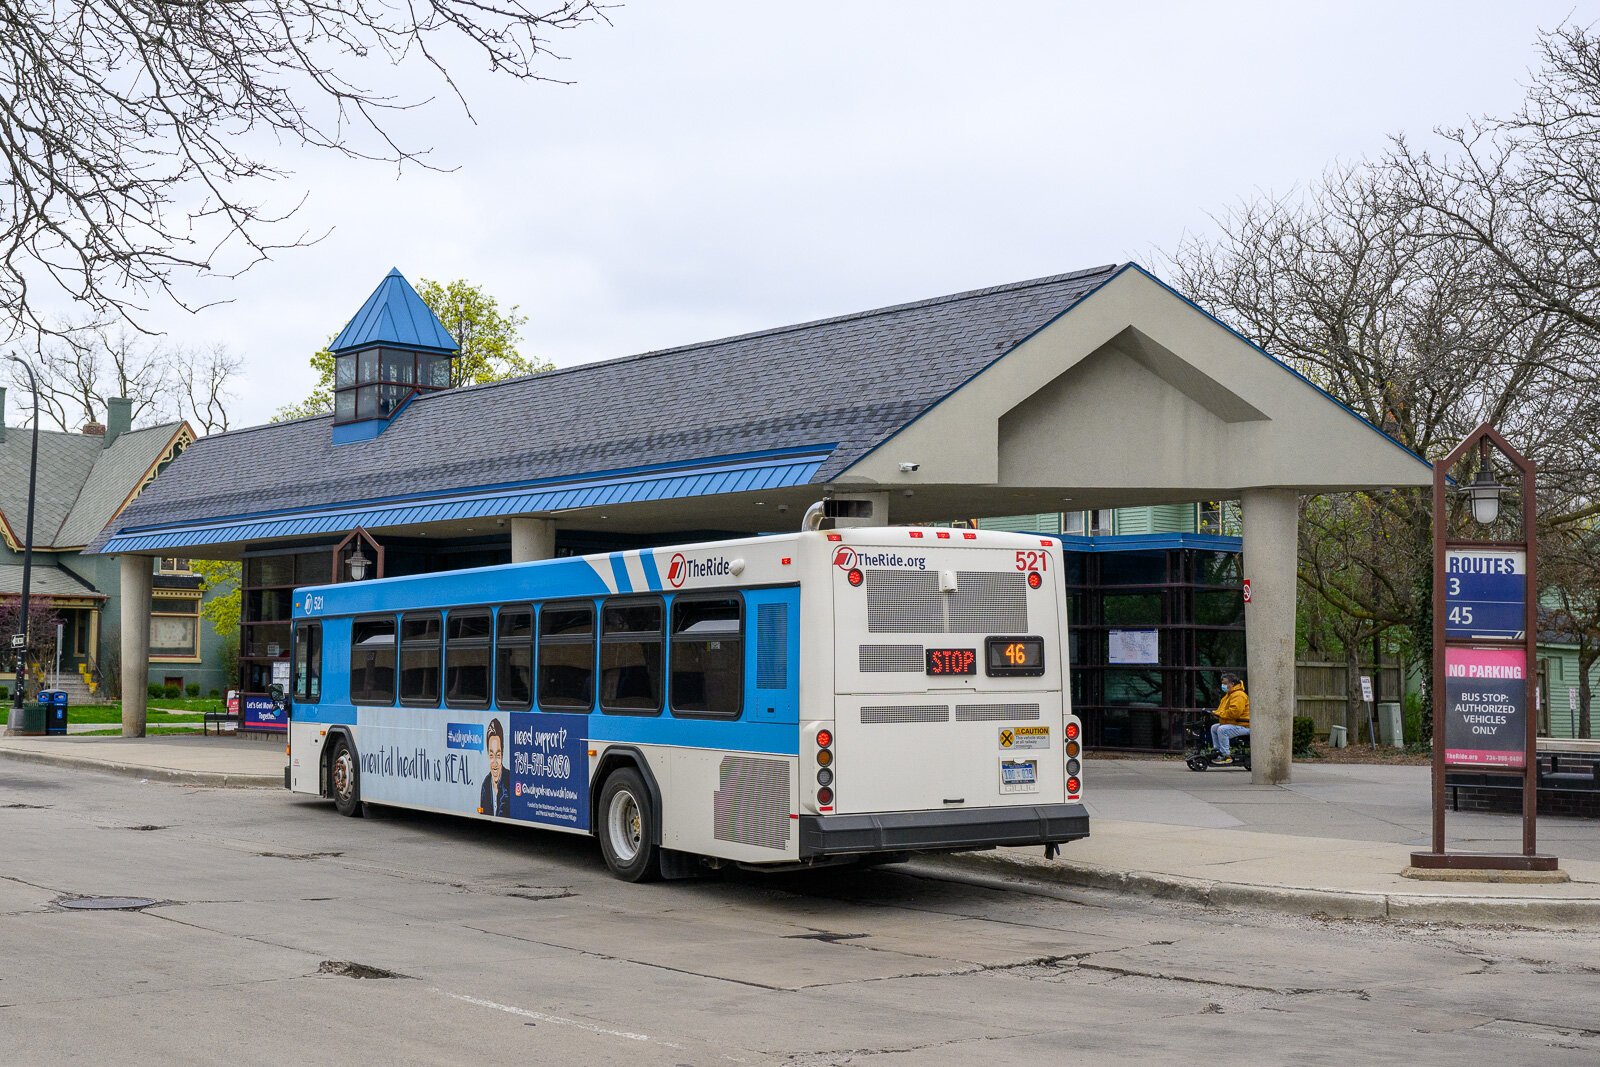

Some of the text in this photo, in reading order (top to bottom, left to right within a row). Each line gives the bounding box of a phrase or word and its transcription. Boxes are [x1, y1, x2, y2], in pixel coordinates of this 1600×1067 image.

[687, 557, 730, 578] TheRide
[857, 553, 926, 570] TheRide.org
[1015, 551, 1047, 571] 521
[1449, 556, 1515, 574] ROUTES
[1449, 577, 1460, 596] 3
[313, 596, 324, 611] 521
[1448, 606, 1473, 625] 45
[932, 650, 974, 673] STOP
[1005, 643, 1025, 664] 46
[1449, 664, 1522, 680] NO PARKING
[1461, 692, 1509, 703] BUS STOP:
[1455, 704, 1516, 714] AUTHORIZED
[1463, 715, 1507, 725] VEHICLES
[514, 725, 567, 754] need support?
[1472, 726, 1498, 735] ONLY
[360, 745, 474, 786] mental health is REAL.
[1446, 753, 1478, 761] TheRide.org
